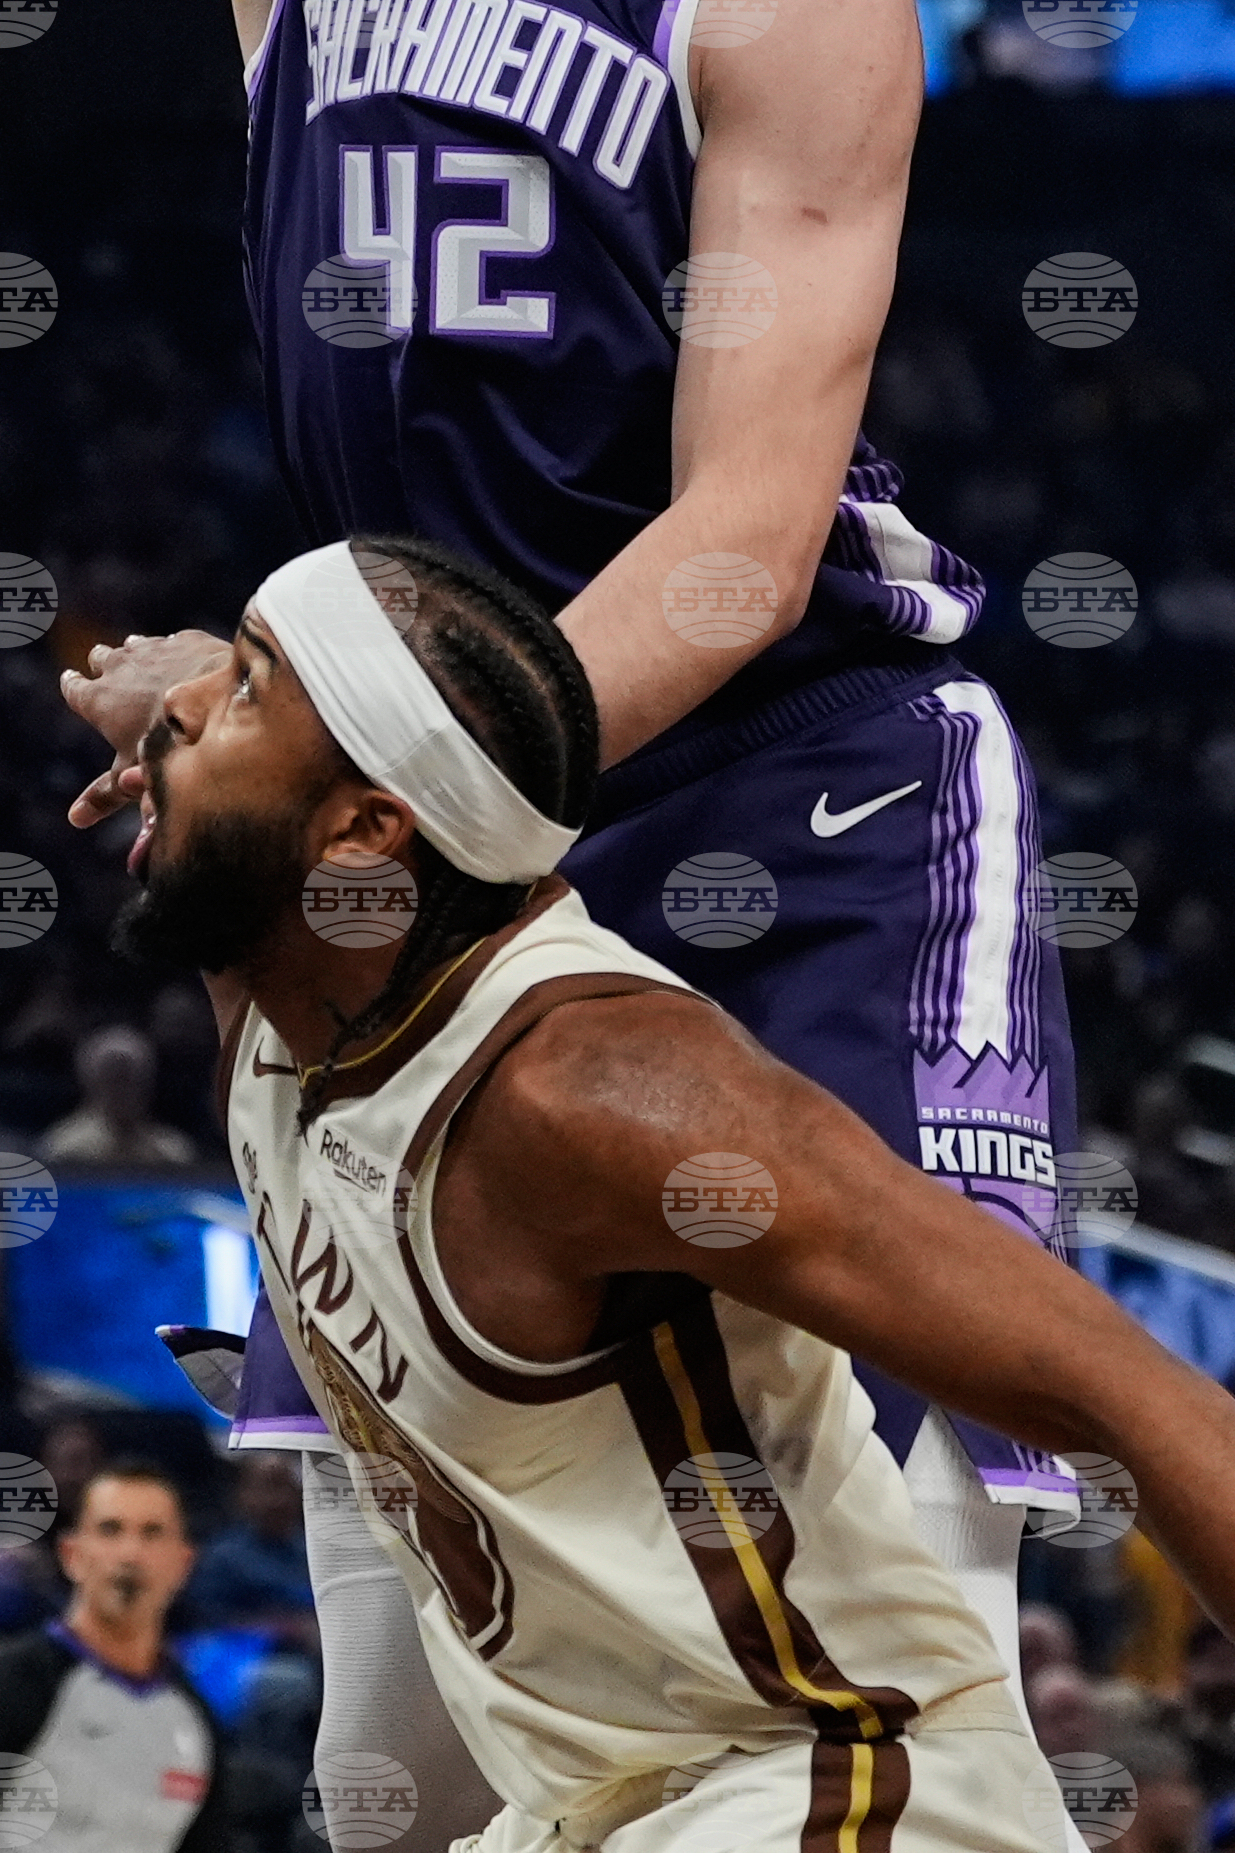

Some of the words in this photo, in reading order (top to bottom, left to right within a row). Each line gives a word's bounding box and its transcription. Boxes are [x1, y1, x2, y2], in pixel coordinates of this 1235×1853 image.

[339, 144, 556, 339] 42
[921, 1106, 1049, 1135] SACRAMENTO
[320, 1128, 387, 1198] Rakuten
[918, 1126, 1057, 1188] KINGS
